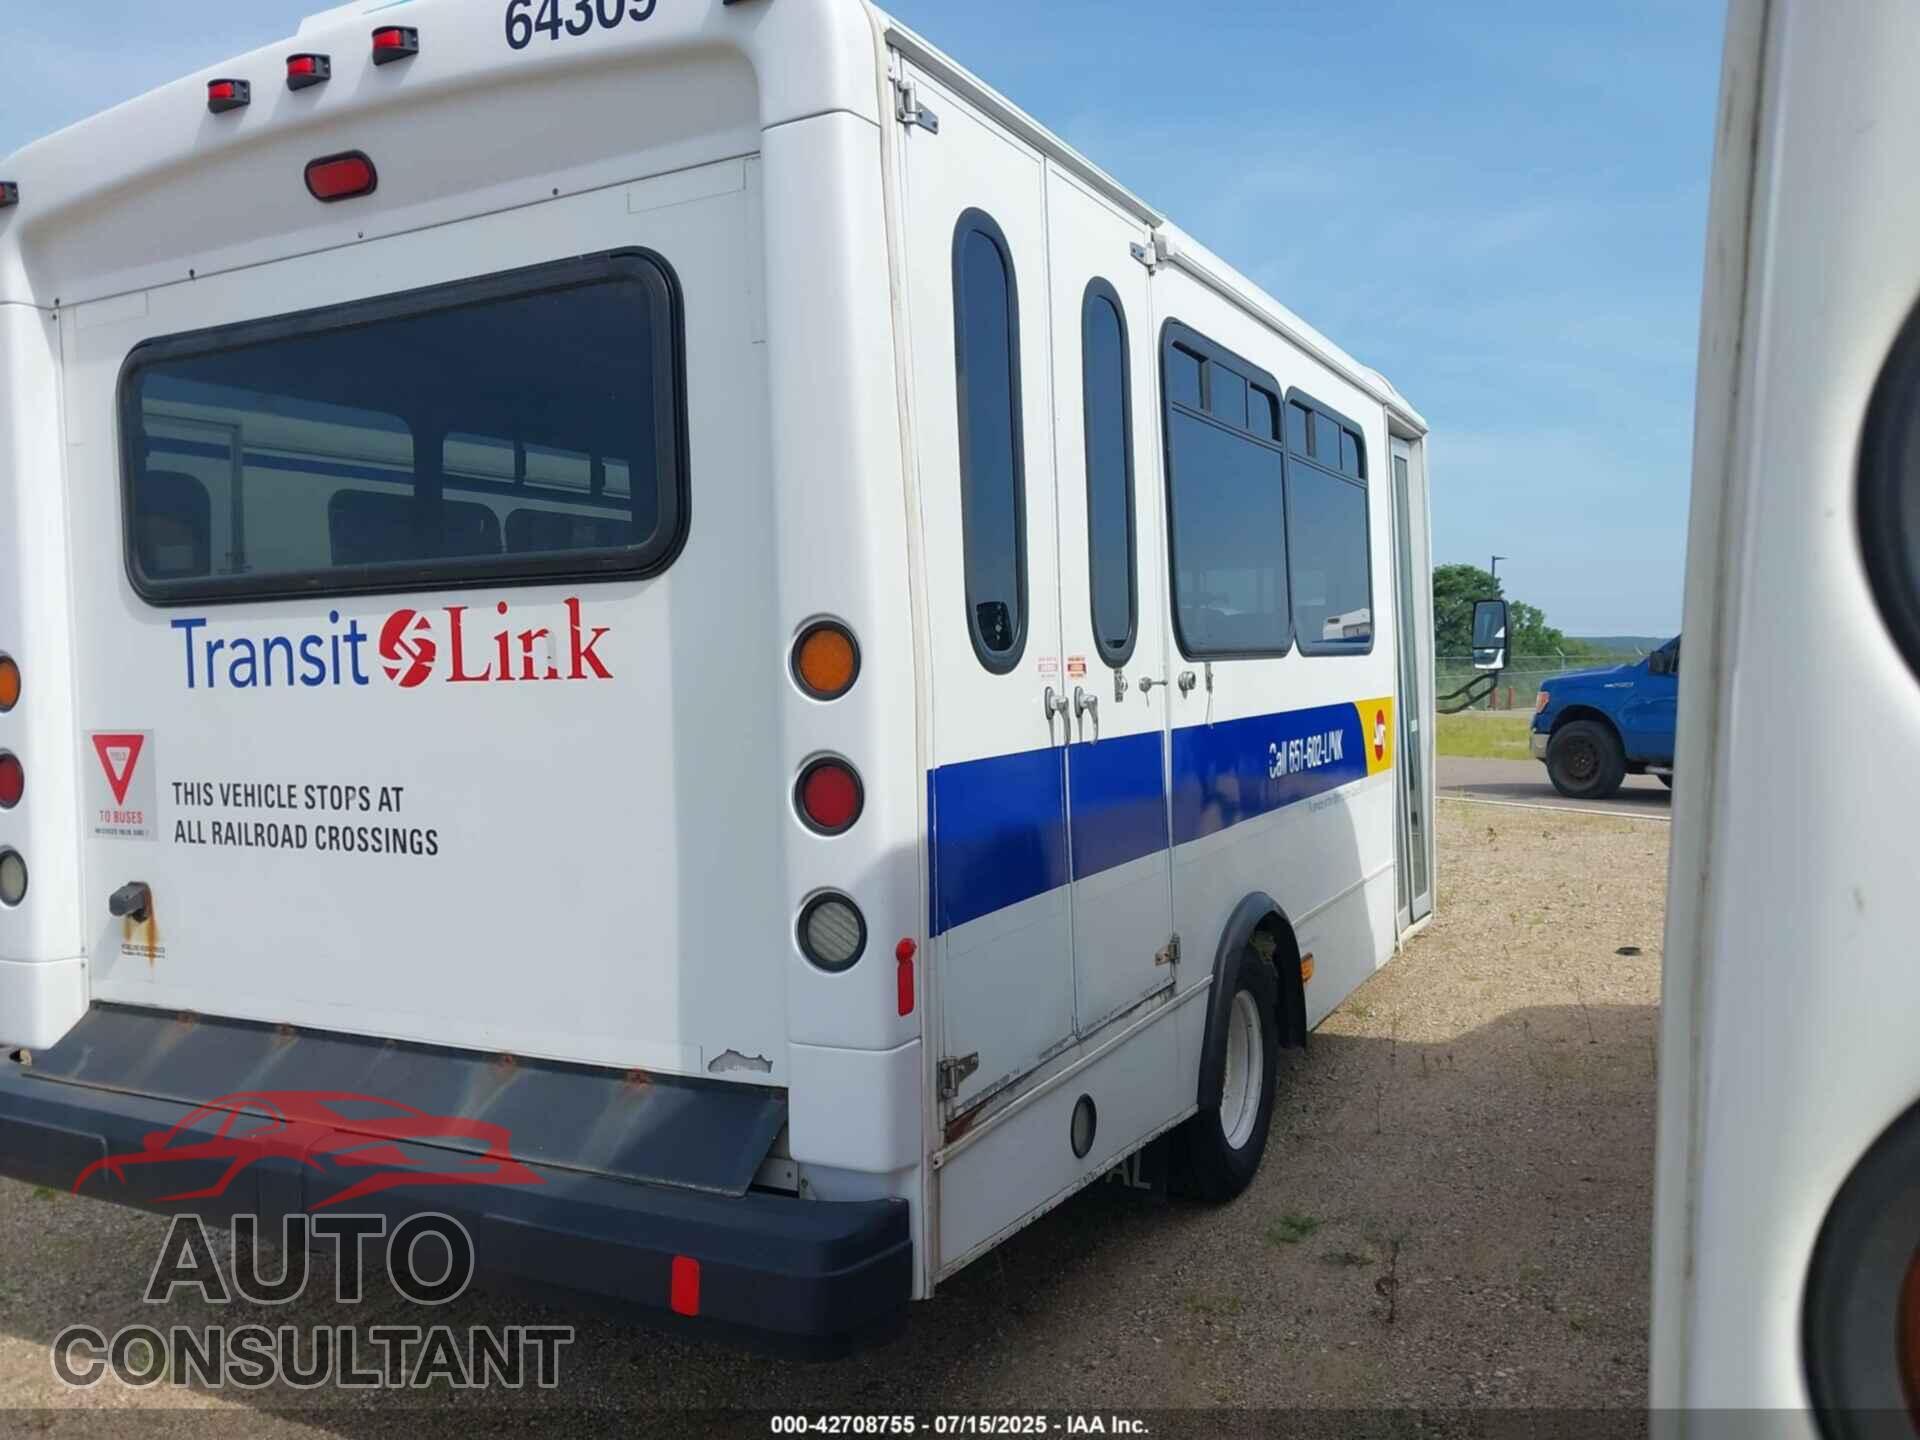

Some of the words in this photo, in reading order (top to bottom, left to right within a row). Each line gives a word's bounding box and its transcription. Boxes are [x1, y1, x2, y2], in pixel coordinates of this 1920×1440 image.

[170, 610, 369, 689] Transit
[443, 596, 614, 683] Link
[1268, 741, 1288, 779] Call
[172, 782, 213, 806] THIS
[219, 783, 298, 809] VEHICLE
[304, 784, 371, 811] STOPS
[378, 786, 404, 812] AT
[113, 810, 143, 825] BUSES
[174, 819, 207, 844] ALL
[211, 821, 307, 849] RAILROAD
[315, 824, 439, 856] CROSSINGS
